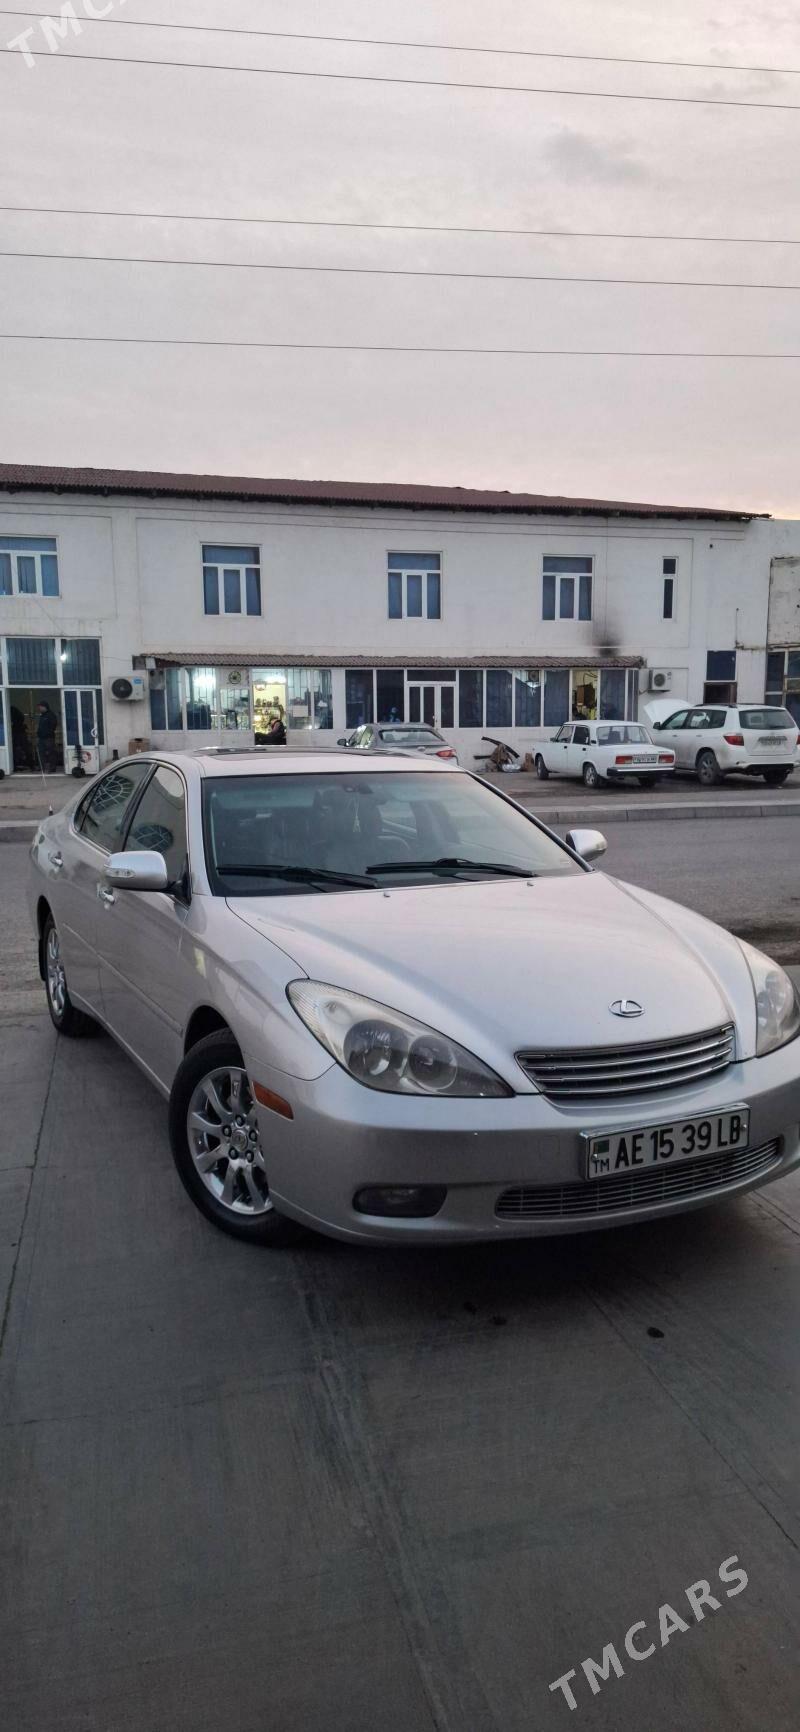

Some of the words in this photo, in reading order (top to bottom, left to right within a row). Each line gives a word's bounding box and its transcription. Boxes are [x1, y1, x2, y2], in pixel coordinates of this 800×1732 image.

[614, 1133, 645, 1169] AE
[650, 1127, 675, 1161] 15
[680, 1121, 712, 1154] 39
[717, 1115, 741, 1148] LB
